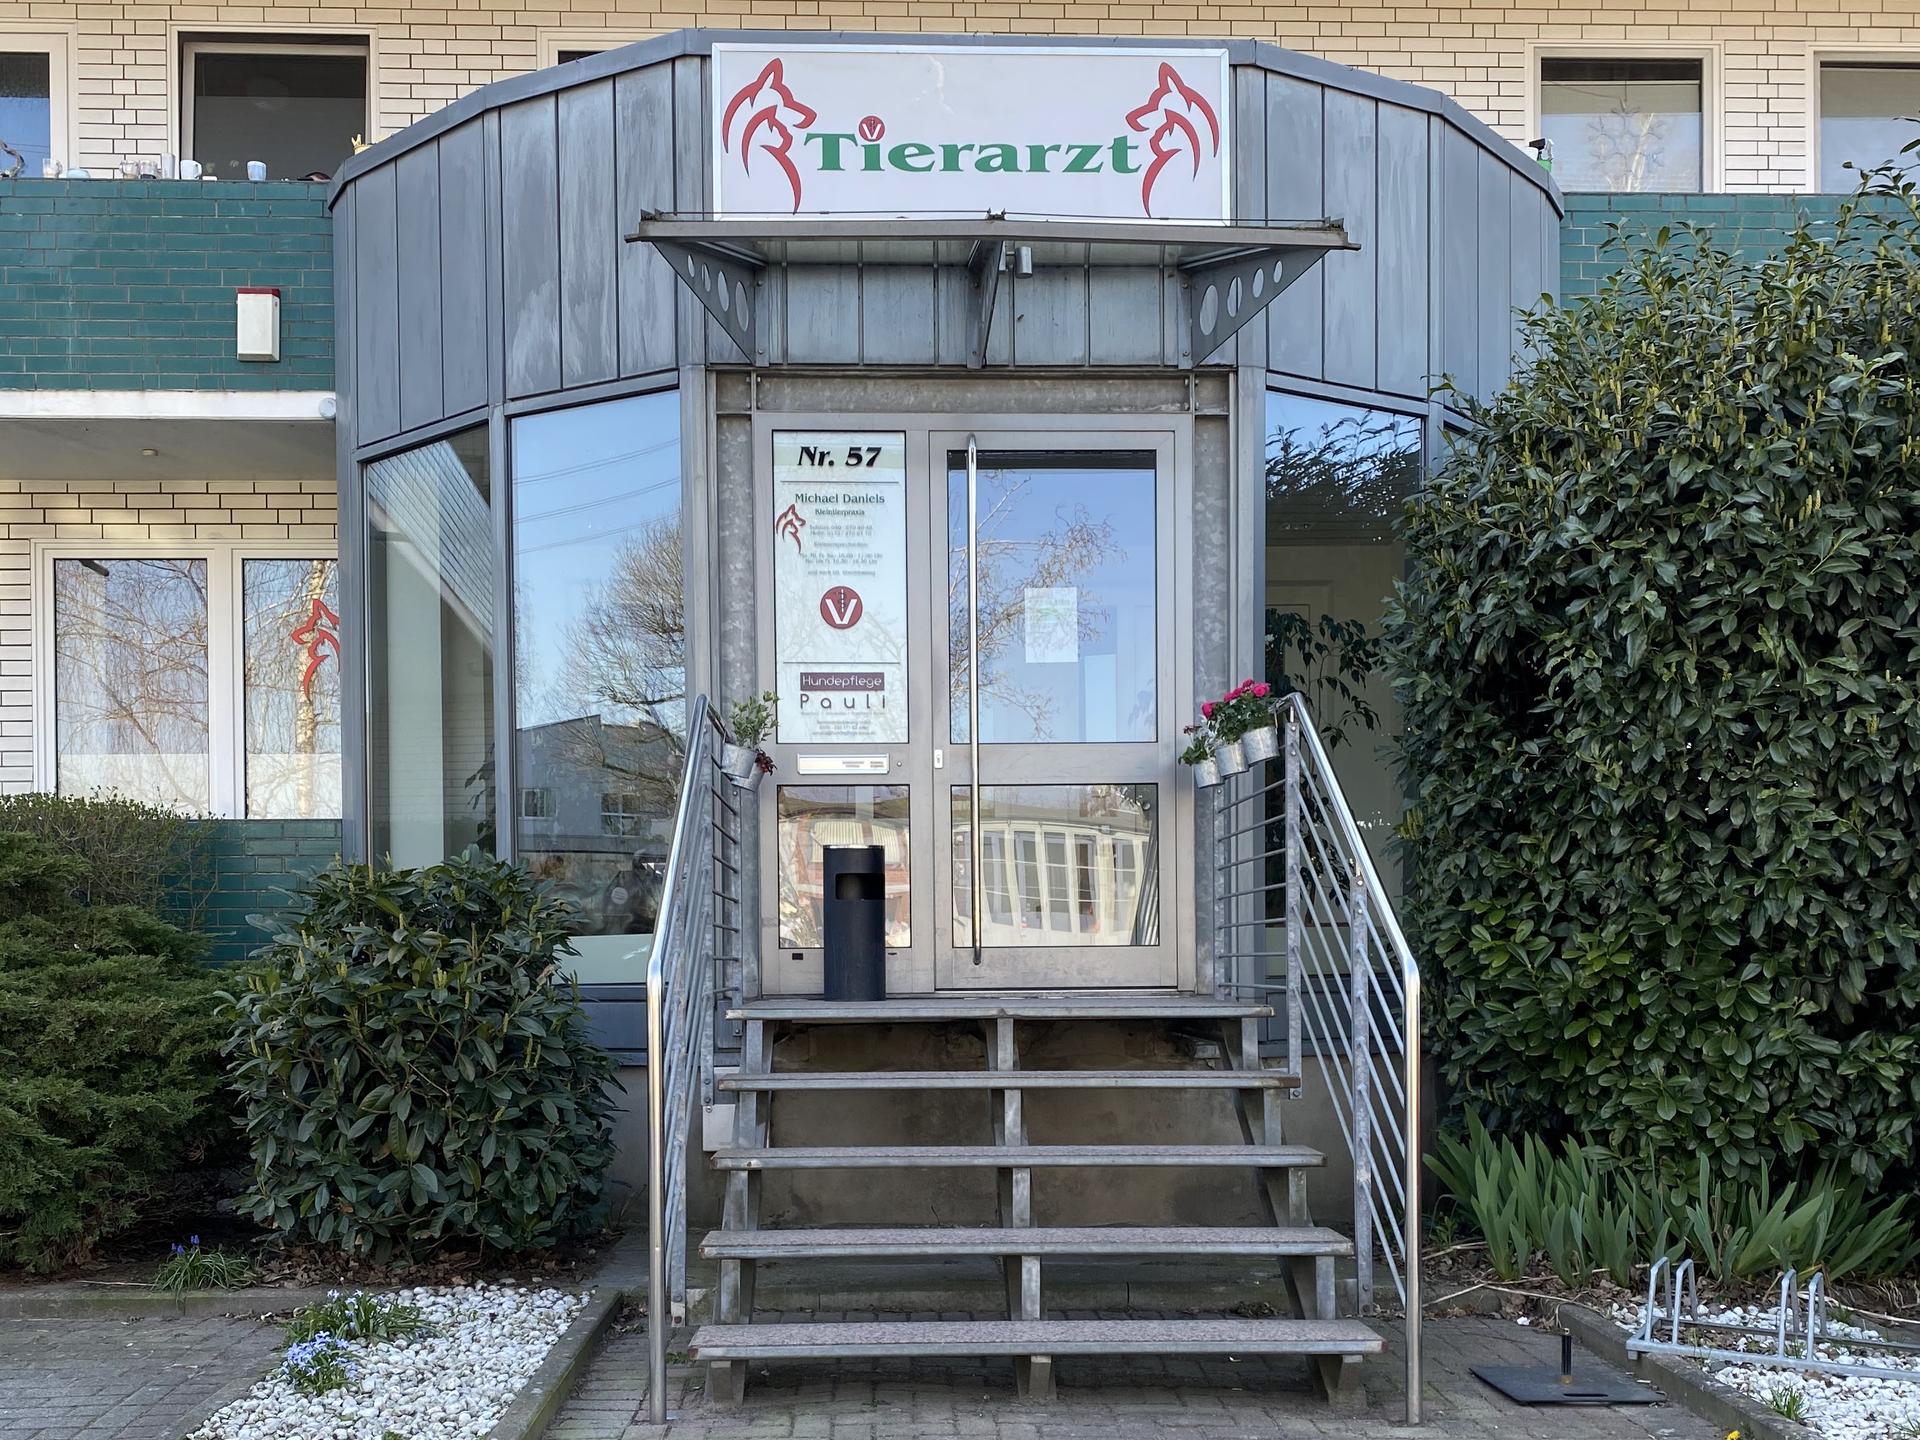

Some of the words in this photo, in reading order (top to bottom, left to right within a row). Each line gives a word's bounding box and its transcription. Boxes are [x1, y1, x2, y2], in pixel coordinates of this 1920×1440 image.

[804, 116, 1142, 174] Tierarzt
[797, 446, 835, 467] Nr.
[845, 446, 882, 467] 57
[795, 493, 839, 504] Michael
[843, 493, 885, 504] Daniels
[815, 508, 865, 517] Kleintierpraxis
[802, 675, 882, 688] Hundepflege
[800, 693, 885, 709] Pauli
